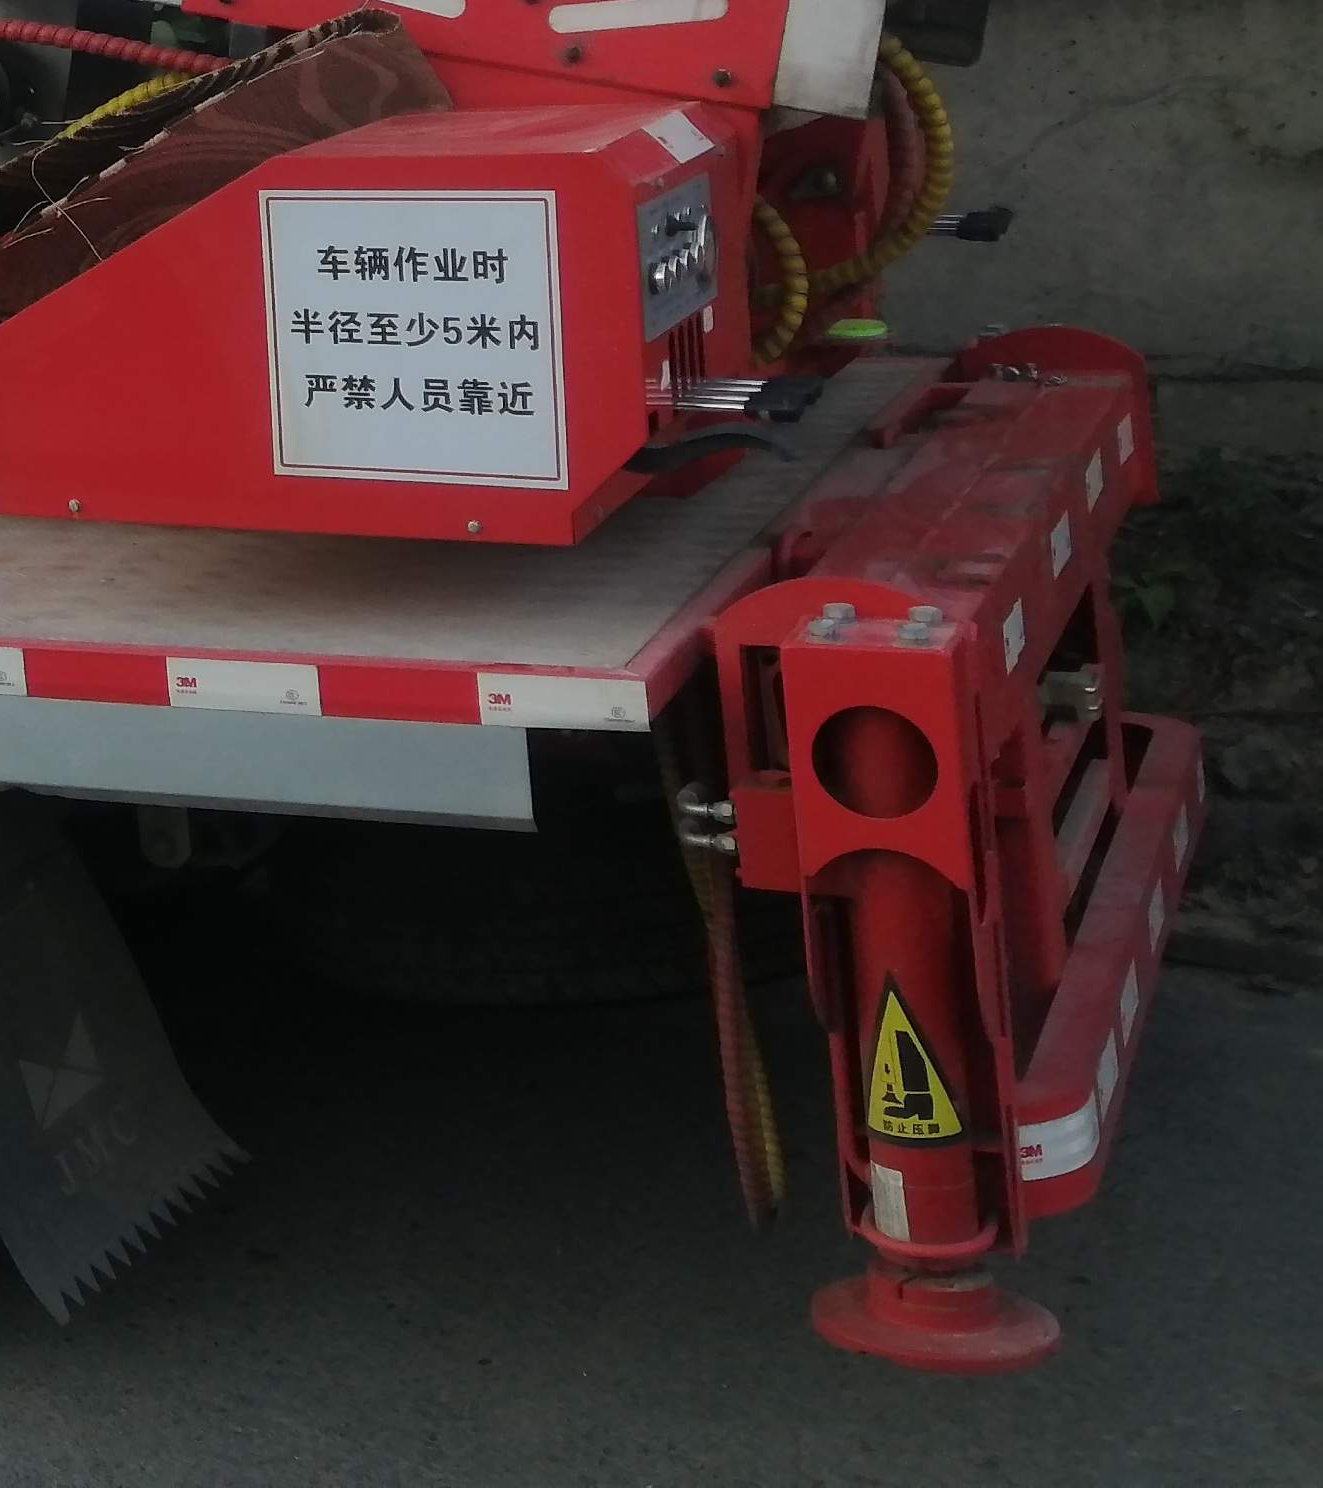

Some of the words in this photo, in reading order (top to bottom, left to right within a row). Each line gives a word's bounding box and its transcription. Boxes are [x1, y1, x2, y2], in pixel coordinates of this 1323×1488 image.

[317, 245, 508, 284] 车辆作业时
[291, 308, 540, 351] 半径至少5米内
[305, 374, 535, 416] 严禁人员靠近
[175, 676, 197, 688] 3M
[488, 693, 512, 706] 3M
[1018, 1143, 1043, 1159] 3M
